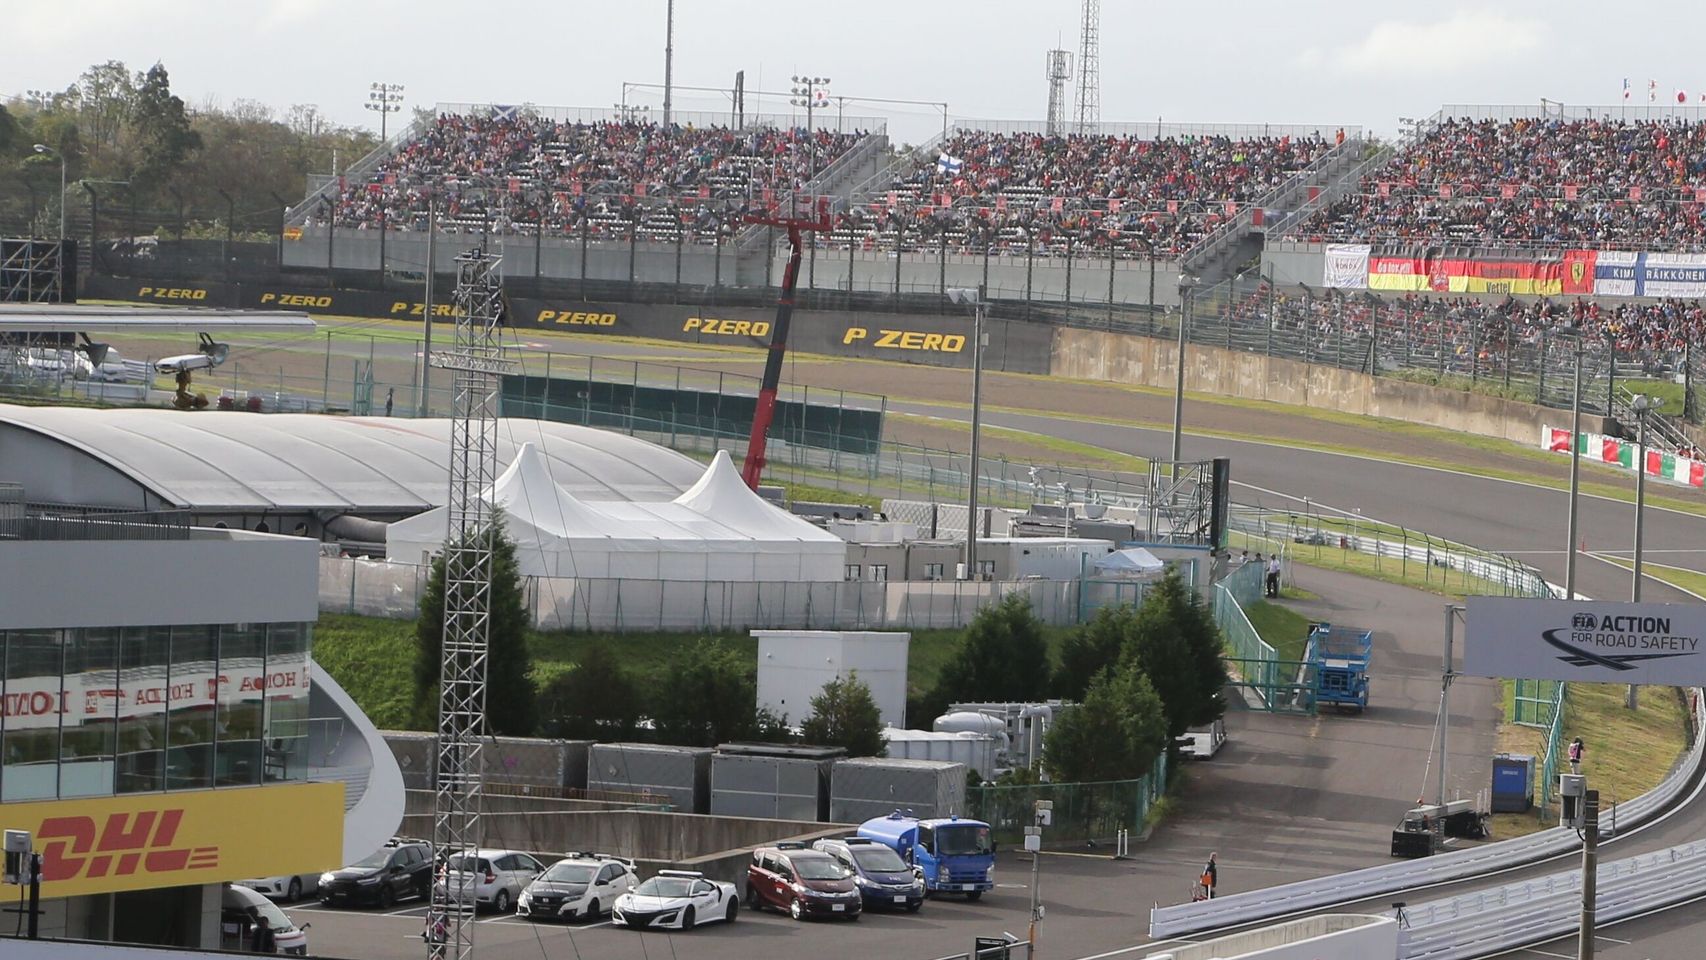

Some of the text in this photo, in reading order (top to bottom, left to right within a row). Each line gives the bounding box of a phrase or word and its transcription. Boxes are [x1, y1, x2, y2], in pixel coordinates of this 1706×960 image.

[1613, 268, 1634, 278] KIMI
[155, 288, 207, 300] ZERO
[278, 294, 333, 308] ZERO
[556, 311, 617, 326] ZERO
[701, 318, 770, 337] ZERO
[843, 328, 966, 352] P ZERO
[1573, 615, 1670, 634] FIA ACTION
[1571, 632, 1699, 650] FOR ROAD SAFETY
[37, 809, 192, 882] DHL
